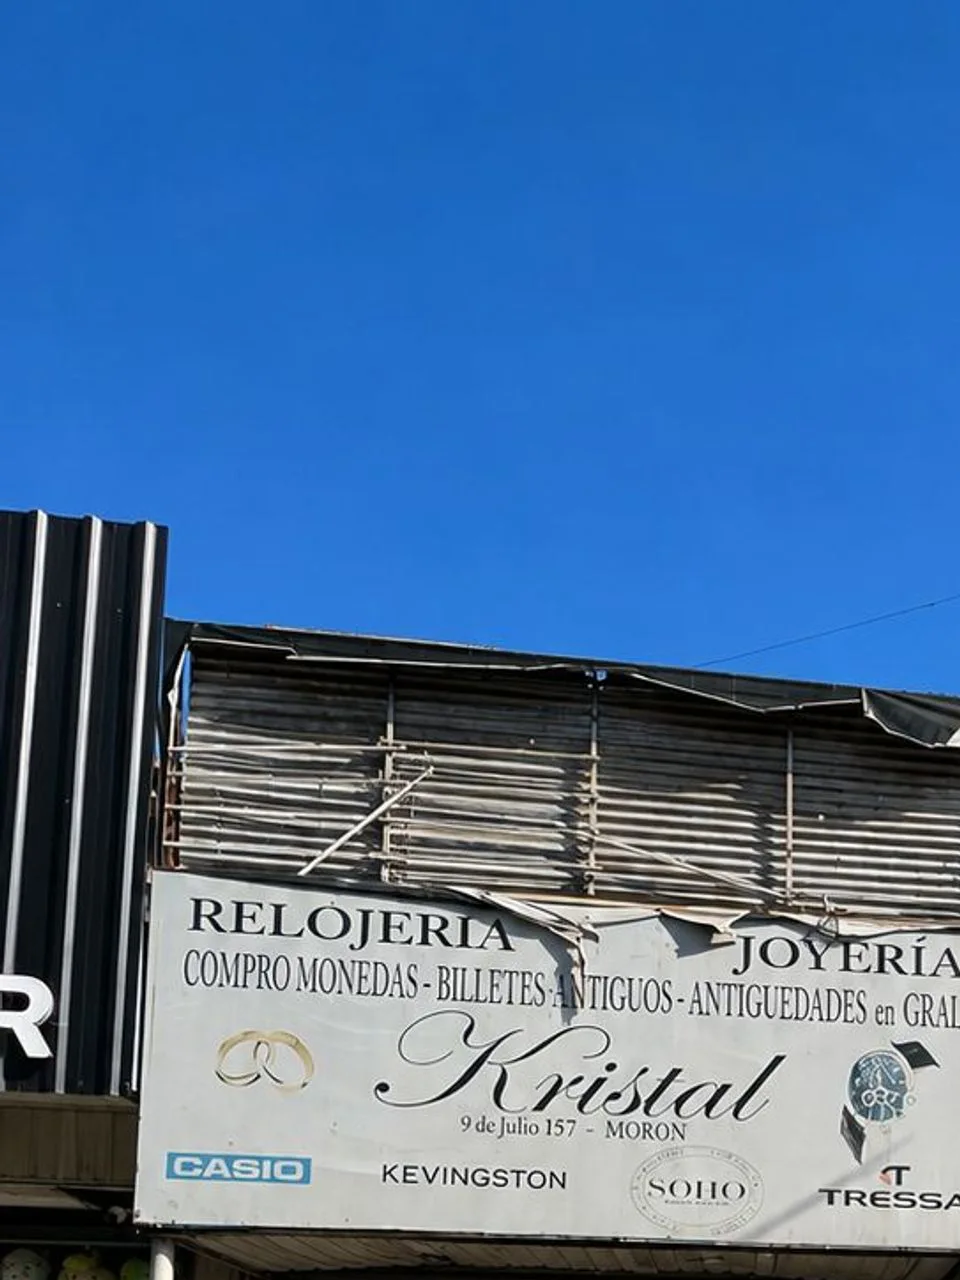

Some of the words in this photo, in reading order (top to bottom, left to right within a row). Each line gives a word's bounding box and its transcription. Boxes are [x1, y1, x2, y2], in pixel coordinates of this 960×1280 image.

[186, 897, 516, 951] RELOJERIA
[183, 948, 291, 992] COMPRO
[296, 956, 418, 1000] MONEDAS
[437, 964, 546, 1008] BILLETES
[552, 973, 673, 1014] ANTIGUOS
[688, 980, 868, 1025] ANTIGUEDADES
[875, 1002, 896, 1027] en
[374, 1009, 787, 1121] Kristal
[460, 1115, 472, 1133] 9
[475, 1115, 497, 1134] de
[497, 1115, 540, 1140] Julio
[546, 1118, 577, 1138] 157
[605, 1119, 688, 1142] MORON
[171, 1155, 306, 1181] CASIO
[381, 1163, 568, 1190] KEVINGSTON
[648, 1177, 747, 1201] SOHO
